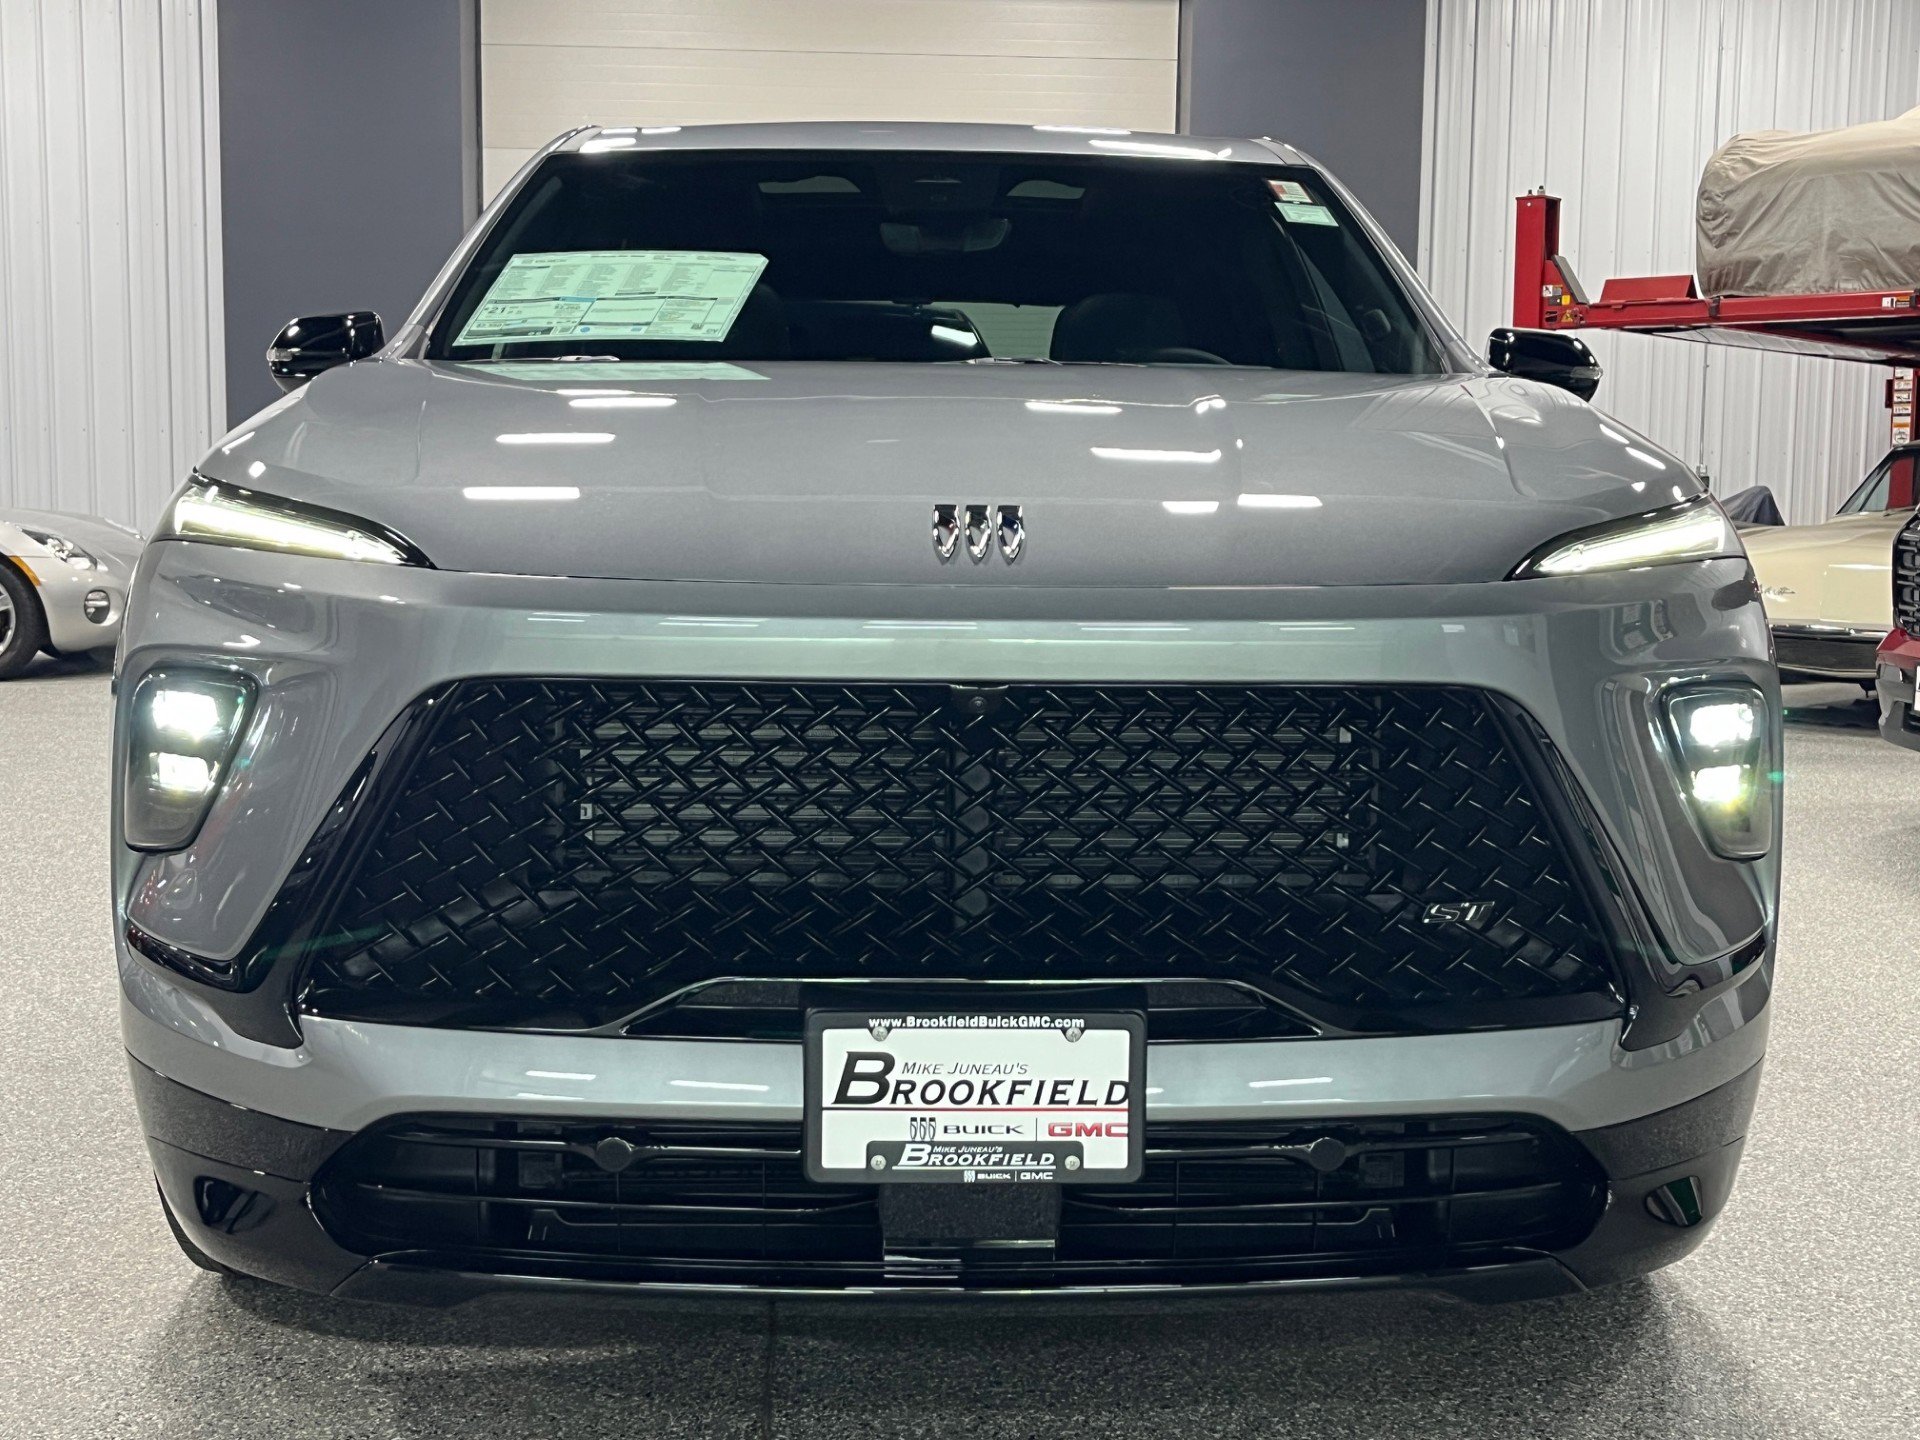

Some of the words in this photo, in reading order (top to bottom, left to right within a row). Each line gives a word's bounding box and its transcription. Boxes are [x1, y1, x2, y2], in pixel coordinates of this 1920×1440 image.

[1422, 902, 1495, 924] ST
[868, 1016, 1085, 1029] www.BrookfieldBuickGMC.com
[901, 1062, 943, 1075] MIKE
[947, 1062, 1028, 1075] JUNEAU'S
[831, 1051, 1130, 1107] BROOKFIELD
[943, 1125, 1024, 1135] BUICK
[1048, 1122, 1129, 1138] GMC
[896, 1144, 1055, 1167] BROOKFIELD
[977, 1172, 1012, 1180] BUICK
[1020, 1172, 1054, 1180] GMC
